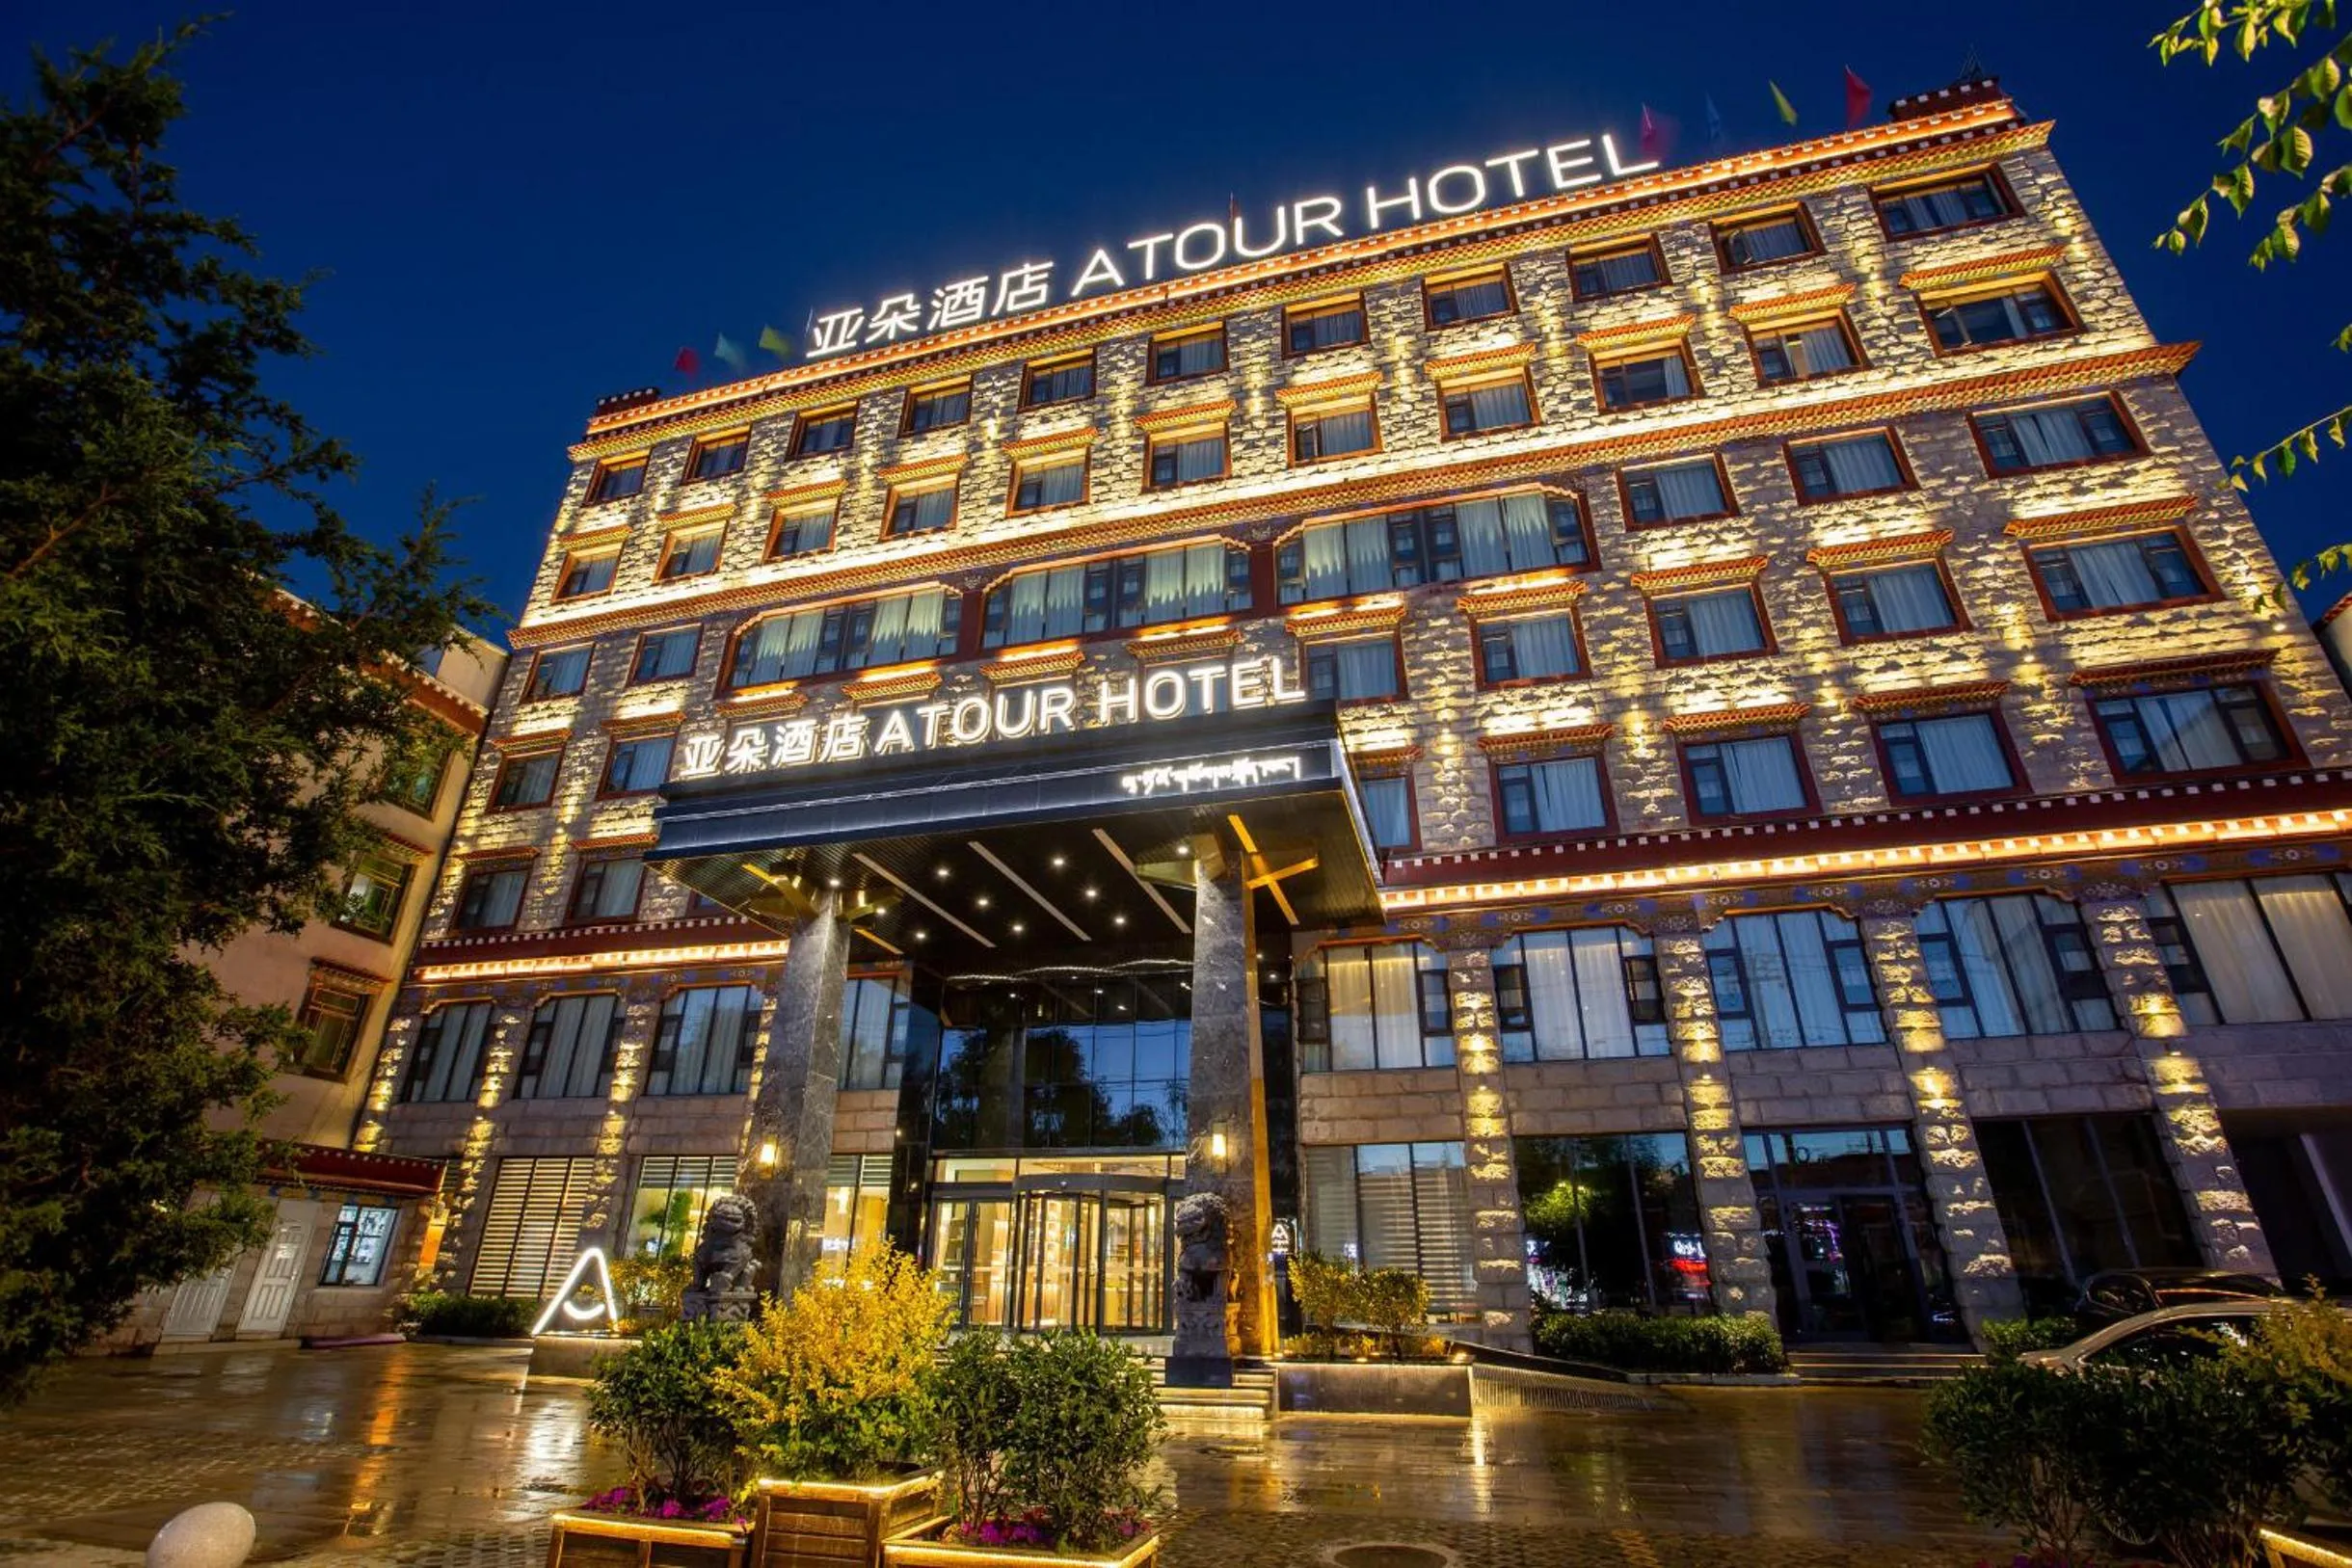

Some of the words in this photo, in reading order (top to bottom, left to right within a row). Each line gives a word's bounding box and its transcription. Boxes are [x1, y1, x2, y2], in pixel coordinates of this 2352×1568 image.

[1070, 196, 1344, 297] ATOUR
[1367, 133, 1660, 229] HOTEL
[807, 261, 1054, 358] 亚朵酒店
[681, 714, 868, 777] 亚朵酒店
[874, 687, 1076, 755] ATOUR
[1100, 656, 1306, 723] HOTEL
